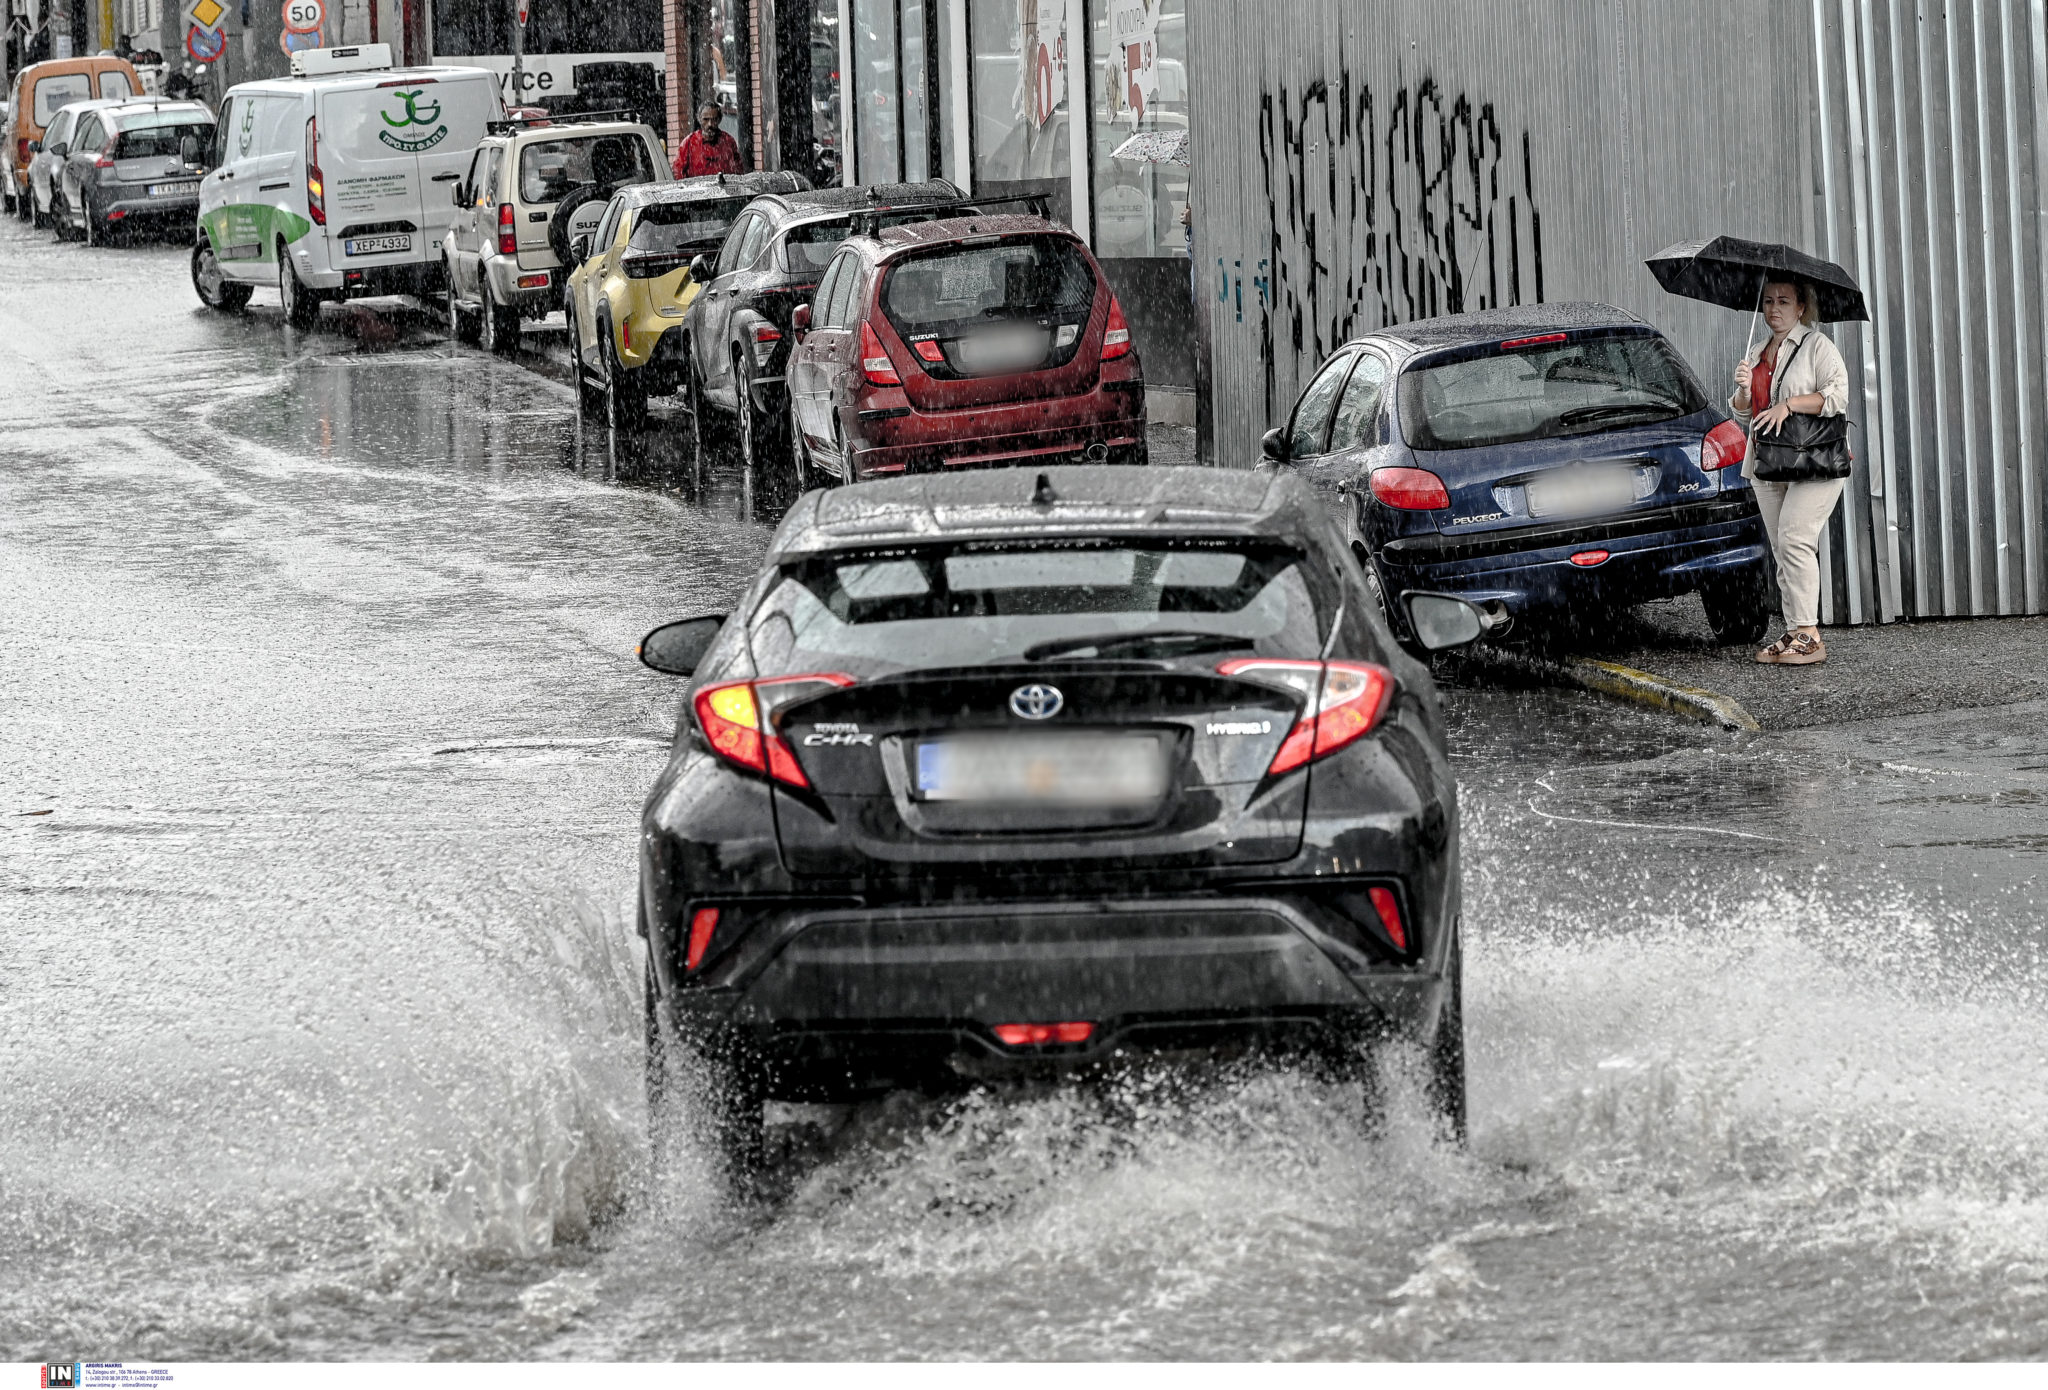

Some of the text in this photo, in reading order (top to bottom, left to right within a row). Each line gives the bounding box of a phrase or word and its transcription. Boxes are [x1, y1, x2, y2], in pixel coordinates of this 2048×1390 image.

[292, 6, 316, 22] 50
[370, 174, 406, 182] ΦΑΡΜΑΚΩΝ
[910, 332, 938, 341] SUZUKI
[1678, 482, 1699, 493] 206
[1452, 512, 1502, 526] PEUGEOT
[803, 734, 874, 746] C-HR
